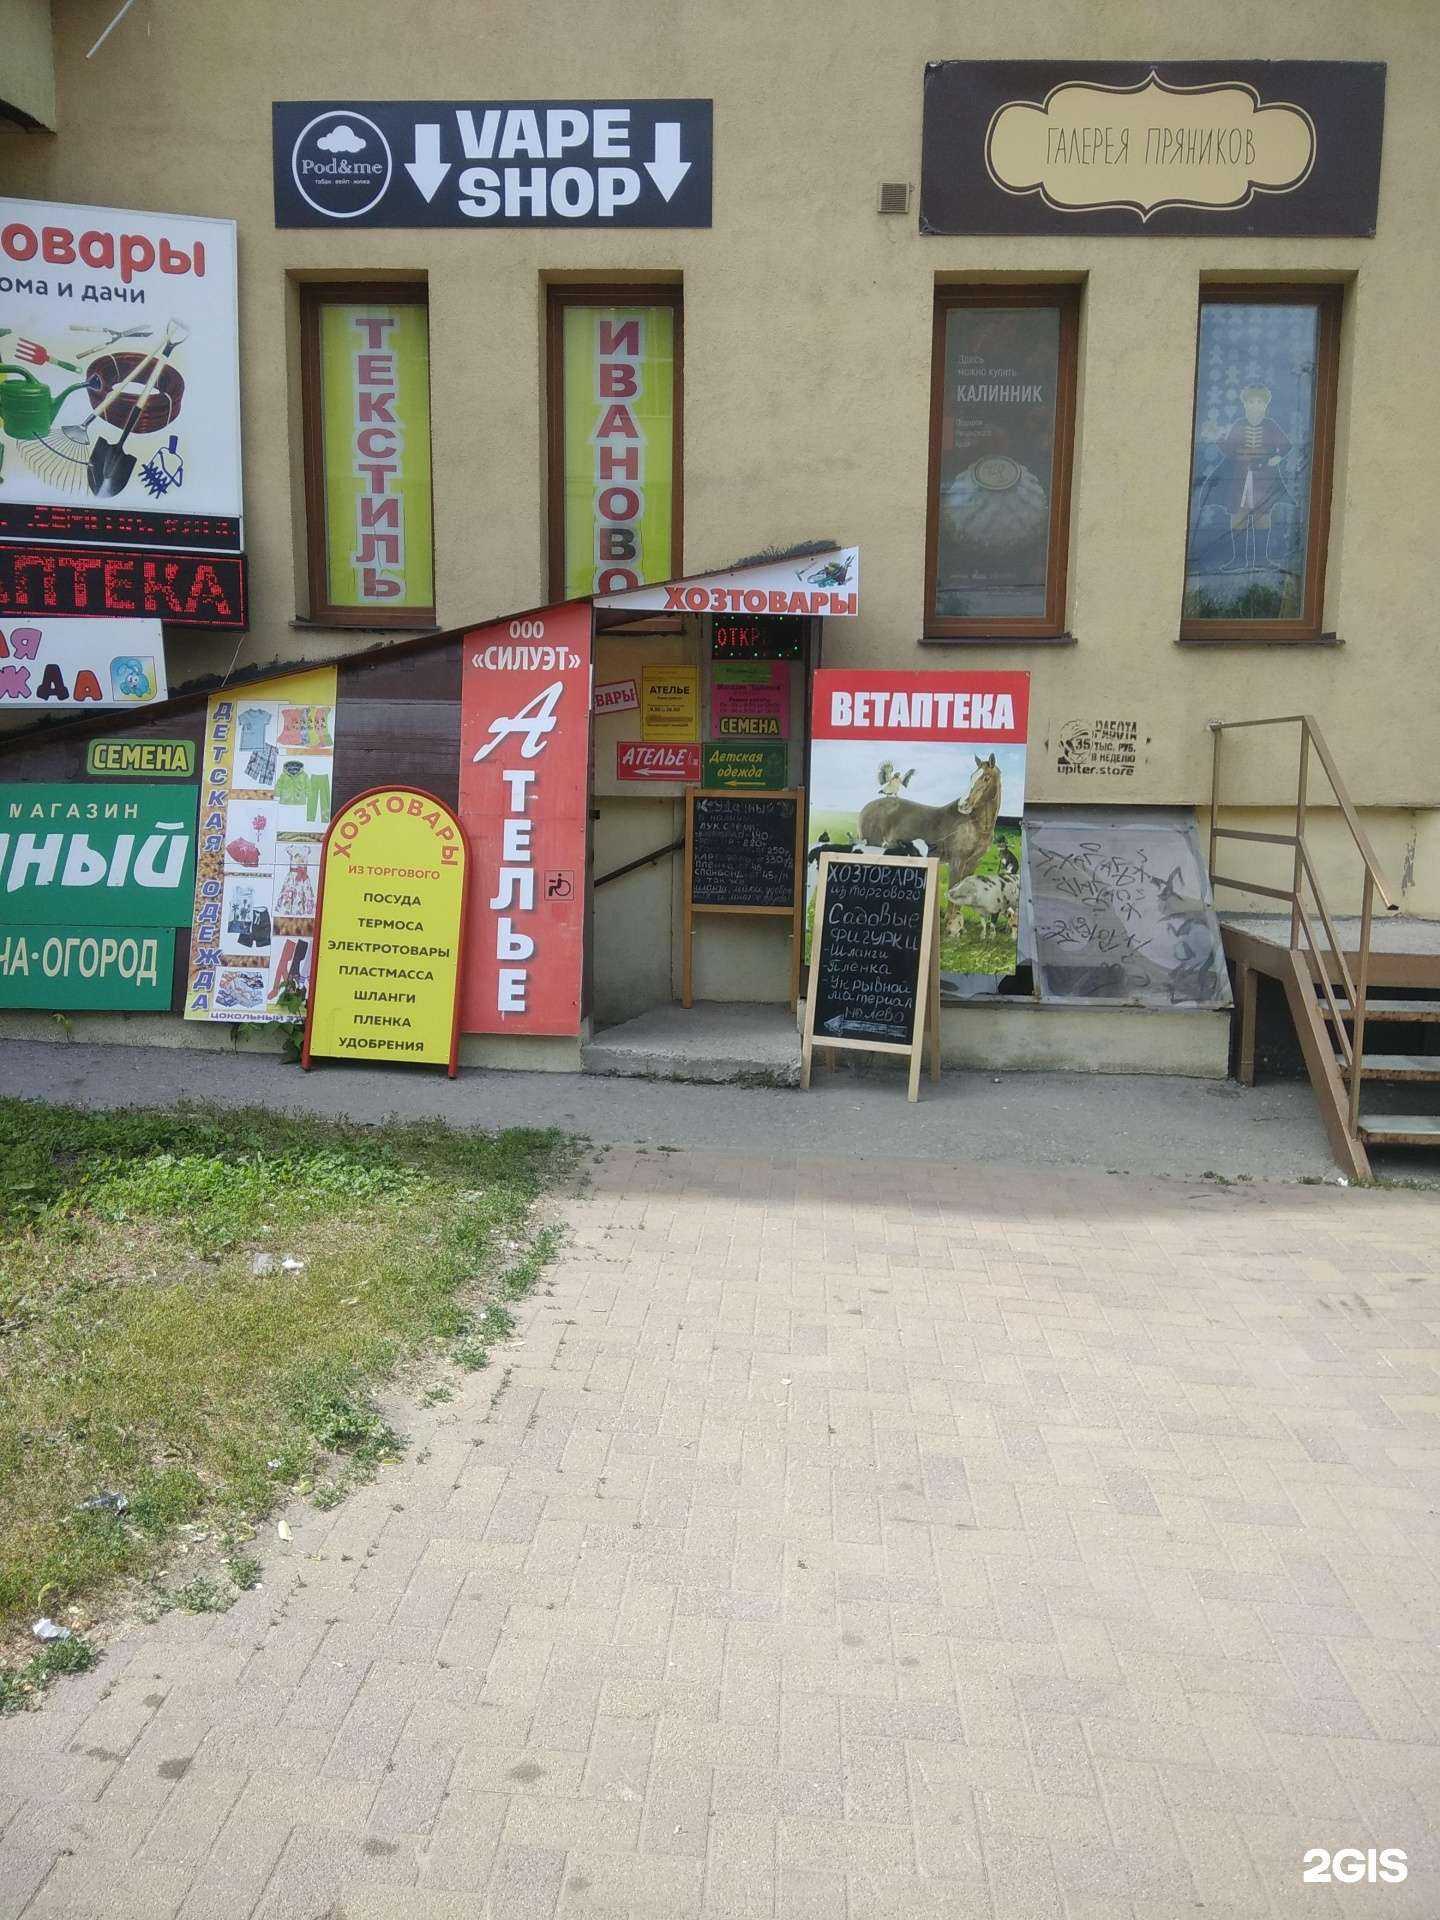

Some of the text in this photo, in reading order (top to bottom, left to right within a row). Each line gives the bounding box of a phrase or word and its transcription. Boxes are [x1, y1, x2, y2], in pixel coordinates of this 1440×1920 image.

[455, 109, 631, 159] VAPE
[1047, 127, 1256, 165] ГАЛЕРЕЯ ПРЯНИКОВ
[302, 157, 383, 174] Pod&me
[458, 167, 641, 218] SHOP
[0, 222, 206, 284] овары
[57, 282, 73, 298] и
[82, 284, 146, 304] дачи
[957, 384, 1043, 402] КАЛИННИК
[355, 318, 402, 598] ТЕКСТИЛЬ
[596, 320, 641, 593] ИВАНОВО
[0, 555, 231, 615] ПТЕКА
[664, 586, 857, 615] ХОЗТОВАРЫ
[509, 620, 545, 639] ООО
[471, 646, 581, 670] «СИЛУЭТ»
[649, 685, 690, 695] АТЕЛЬЕ
[831, 691, 1015, 730] ВЕТАПТЕКА
[720, 717, 780, 735] СЕМЕНА
[93, 743, 188, 771] СЕМЕНА
[622, 747, 688, 766] АТЕЛЬЕ
[709, 750, 763, 763] Детская
[1100, 753, 1136, 763] НЕДЕЛЮ
[717, 764, 763, 778] одежда
[9, 803, 138, 819] МАГАЗИН
[333, 796, 459, 866] ХОЗТОВАРЫ
[473, 680, 563, 1012] АТЕЛЬЕ
[190, 701, 234, 1011] ДЕТСКАЯ ОДЕЖДА
[348, 864, 440, 880] ИЗ ТОРГОВОГО
[363, 892, 422, 906] ПОСУДА
[358, 918, 424, 931] ТЕРМОСА
[829, 903, 920, 928] Садовые
[327, 940, 450, 958] ЭЛЕКТРОТОВАРЫ
[338, 965, 434, 981] ПЛАСТМАССА
[353, 990, 416, 1004] ШЛАНГИ
[353, 1014, 412, 1028] ПЛЕНКА
[338, 1036, 424, 1052] УДОБРЕНИЯ
